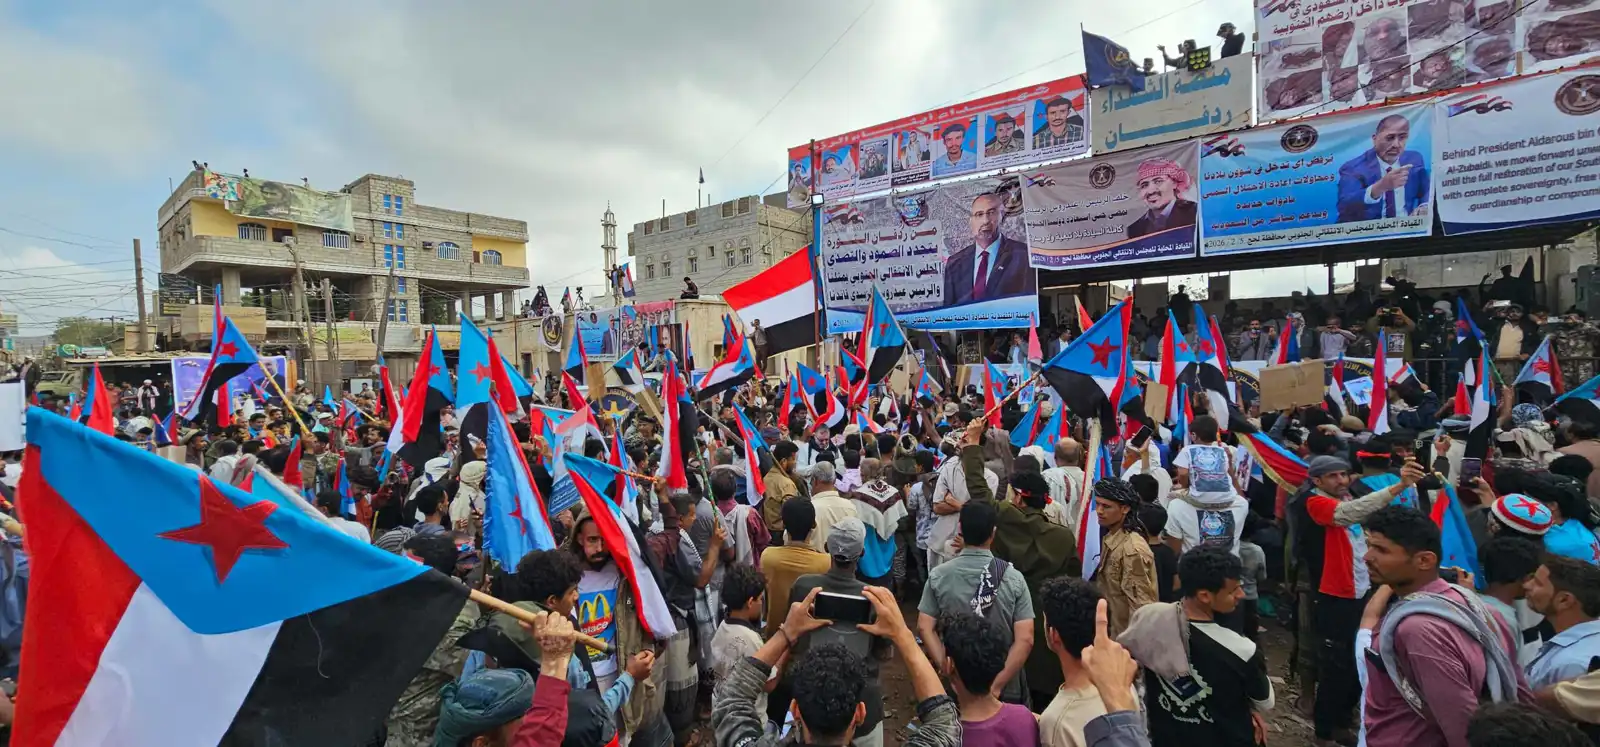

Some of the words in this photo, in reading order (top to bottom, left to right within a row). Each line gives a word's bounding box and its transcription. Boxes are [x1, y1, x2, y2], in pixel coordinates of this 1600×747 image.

[1356, 0, 1384, 17] داخل
[1273, 16, 1315, 36] الجنوبية
[1101, 72, 1169, 114] الشداء
[1442, 145, 1476, 160] Behind
[1478, 139, 1526, 155] President
[1577, 129, 1595, 140] bin
[1495, 159, 1509, 167] we
[1510, 154, 1537, 165] move
[1538, 148, 1575, 161] forward
[1442, 176, 1461, 187] until
[1462, 174, 1477, 184] the
[1479, 171, 1493, 182] full
[1494, 165, 1544, 180] restoration
[1545, 162, 1556, 173] of
[1557, 161, 1573, 171] our
[1442, 190, 1462, 200] with
[1464, 185, 1509, 198] complete
[1575, 173, 1598, 184] free
[1535, 194, 1547, 203] or
[1400, 218, 1423, 229] القيادة
[1261, 232, 1286, 241] محافظة
[1287, 230, 1313, 243] الجنوبي
[827, 248, 867, 270] والتصدي
[869, 244, 904, 263] الصمود
[907, 242, 939, 258] يتجدد
[880, 264, 914, 285] الانتقالي
